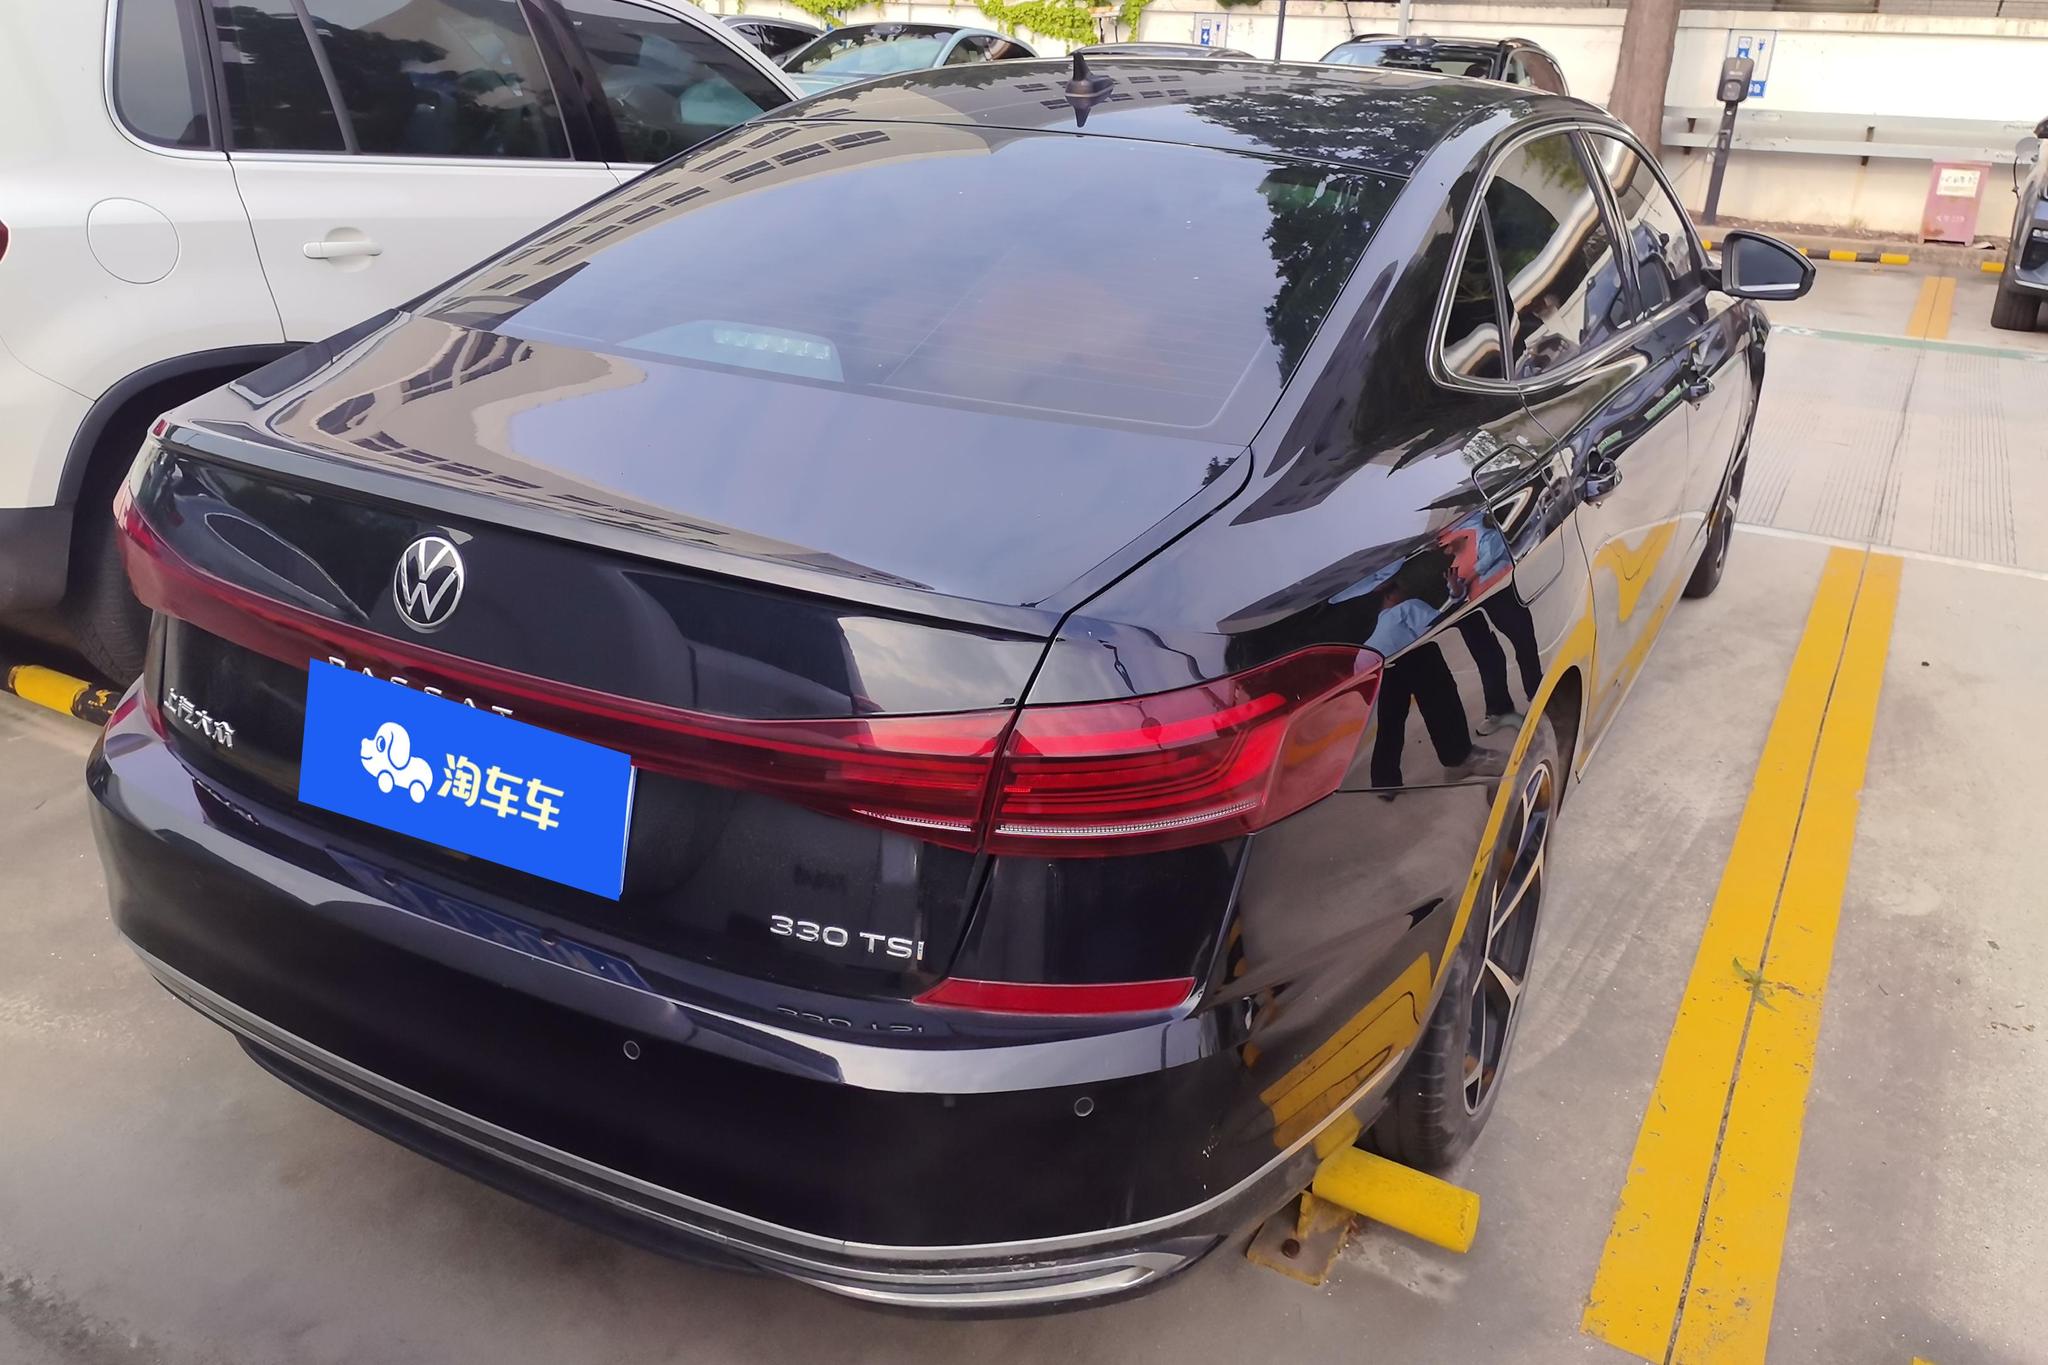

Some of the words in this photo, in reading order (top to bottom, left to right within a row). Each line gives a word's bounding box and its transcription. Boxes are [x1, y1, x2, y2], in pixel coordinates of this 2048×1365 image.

[163, 687, 235, 748] 上汽大众
[769, 915, 849, 948] 330
[859, 931, 925, 961] TSI
